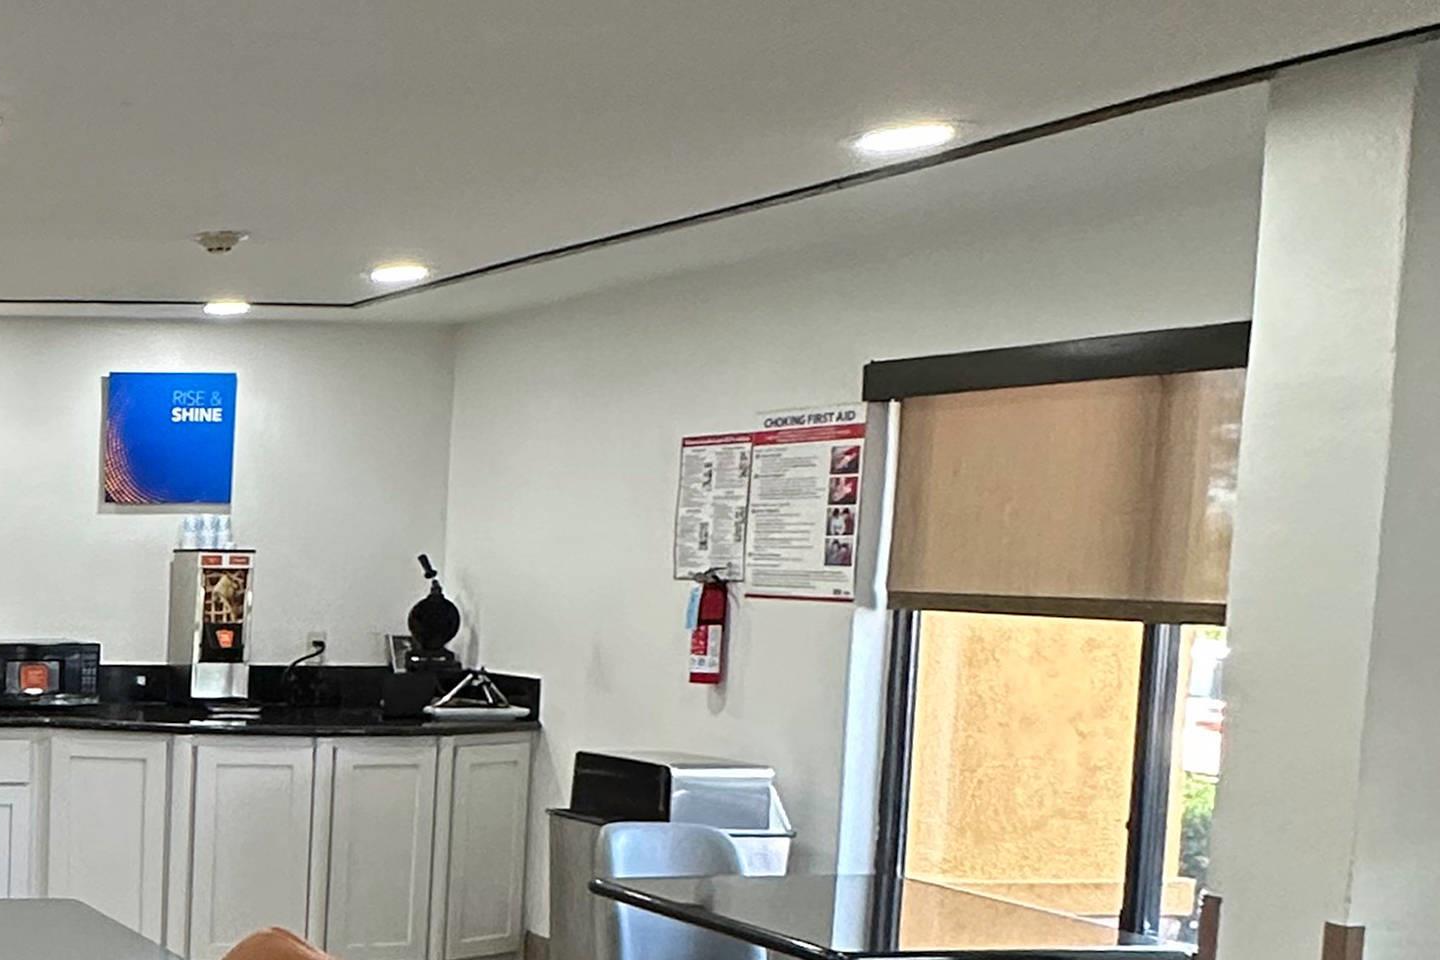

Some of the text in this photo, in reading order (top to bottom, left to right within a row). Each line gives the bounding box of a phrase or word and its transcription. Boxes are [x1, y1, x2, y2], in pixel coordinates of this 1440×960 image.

[172, 390, 222, 406] RISE &
[171, 407, 223, 422] SHINE
[763, 410, 856, 428] CHOKING FIRST AID
